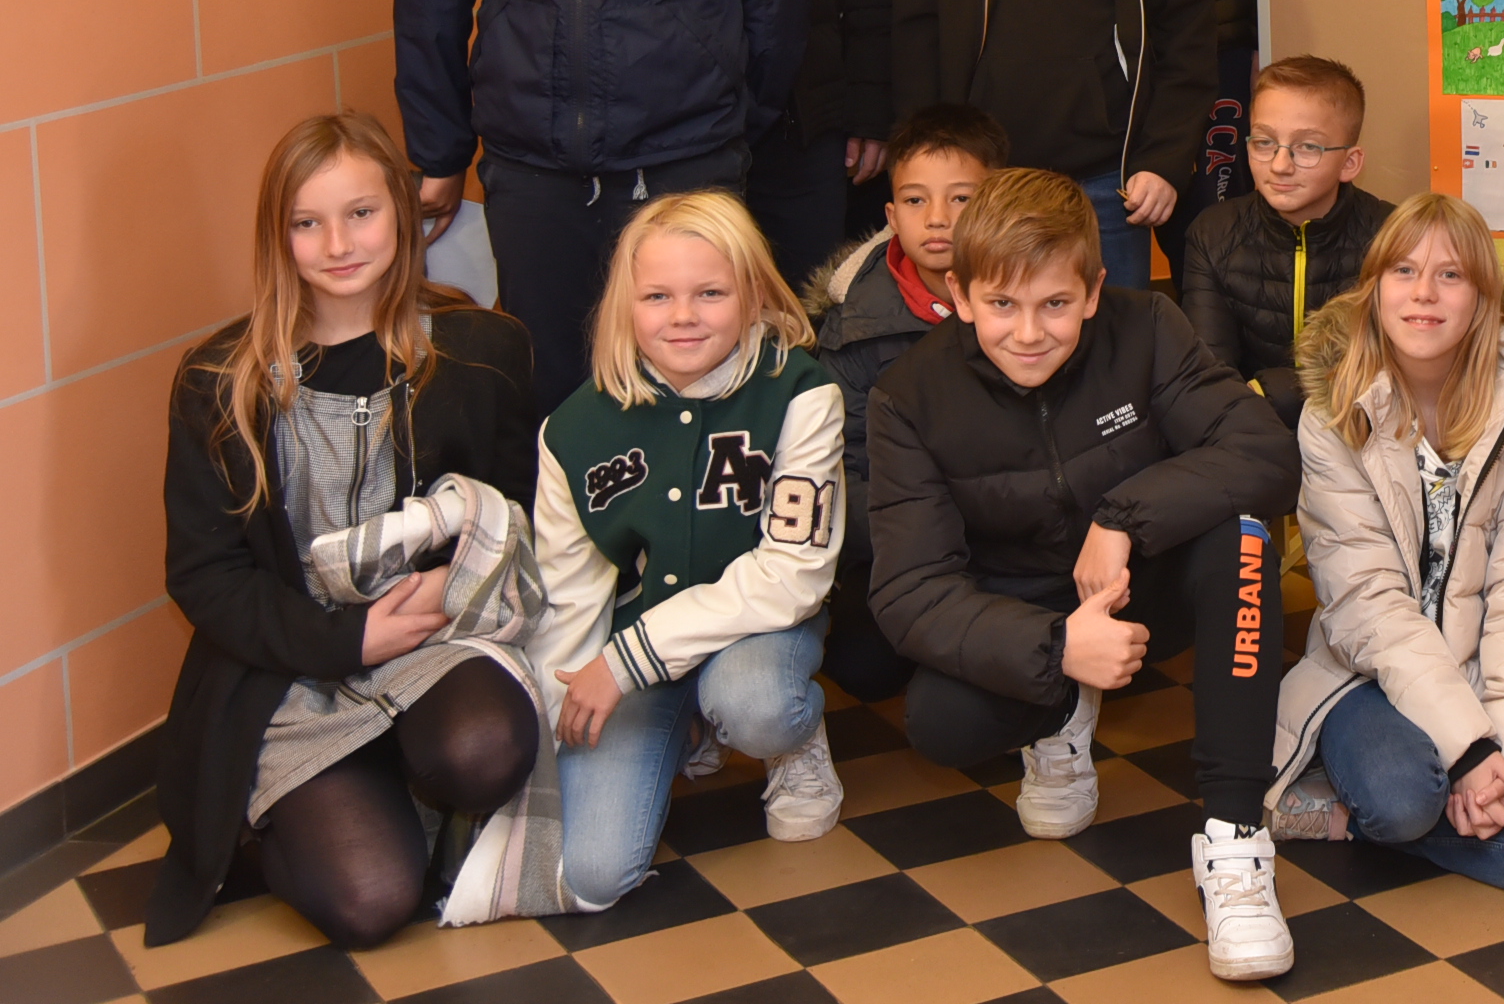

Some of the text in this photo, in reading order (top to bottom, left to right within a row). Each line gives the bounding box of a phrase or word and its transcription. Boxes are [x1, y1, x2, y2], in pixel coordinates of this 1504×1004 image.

[1096, 402, 1134, 426] ACTIVE VIBES
[767, 475, 837, 548] 91
[1232, 554, 1263, 678] URBAN
